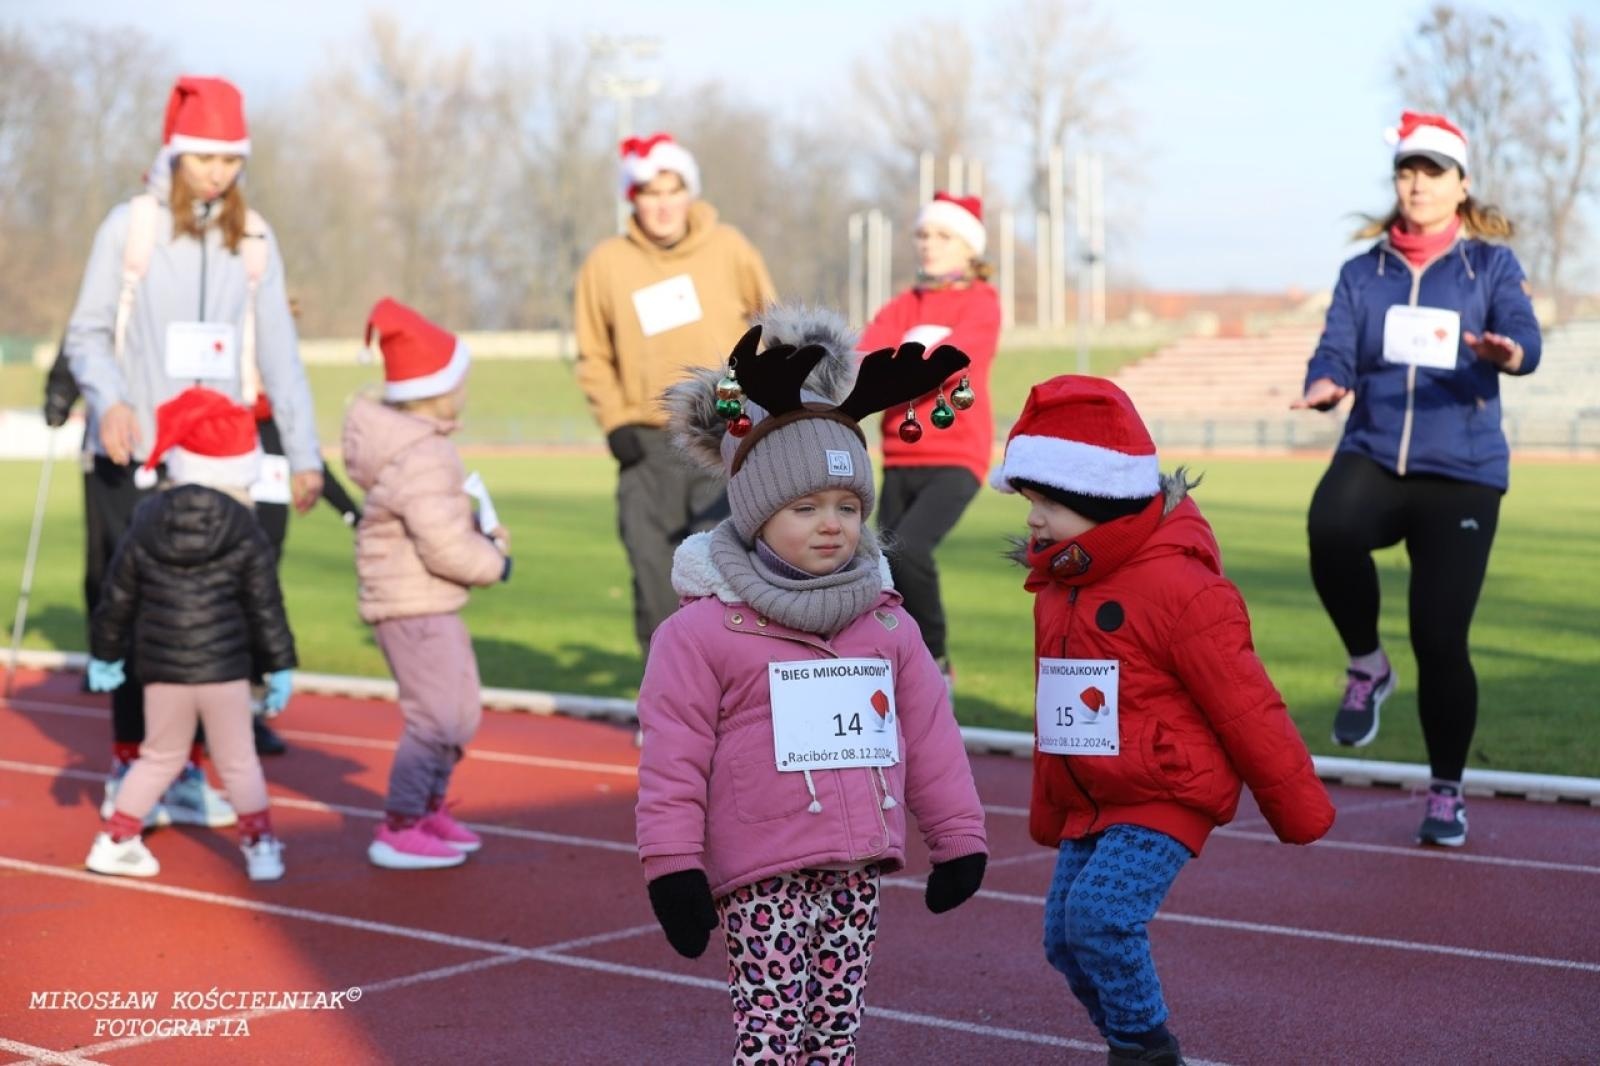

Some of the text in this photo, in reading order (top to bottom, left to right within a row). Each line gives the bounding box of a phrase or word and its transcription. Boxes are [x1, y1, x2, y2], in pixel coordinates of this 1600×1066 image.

[781, 665, 886, 681] BIEG MIKOŁAJKOWY
[832, 712, 863, 737] 14
[1056, 706, 1074, 727] 15
[788, 749, 839, 763] Racibórz
